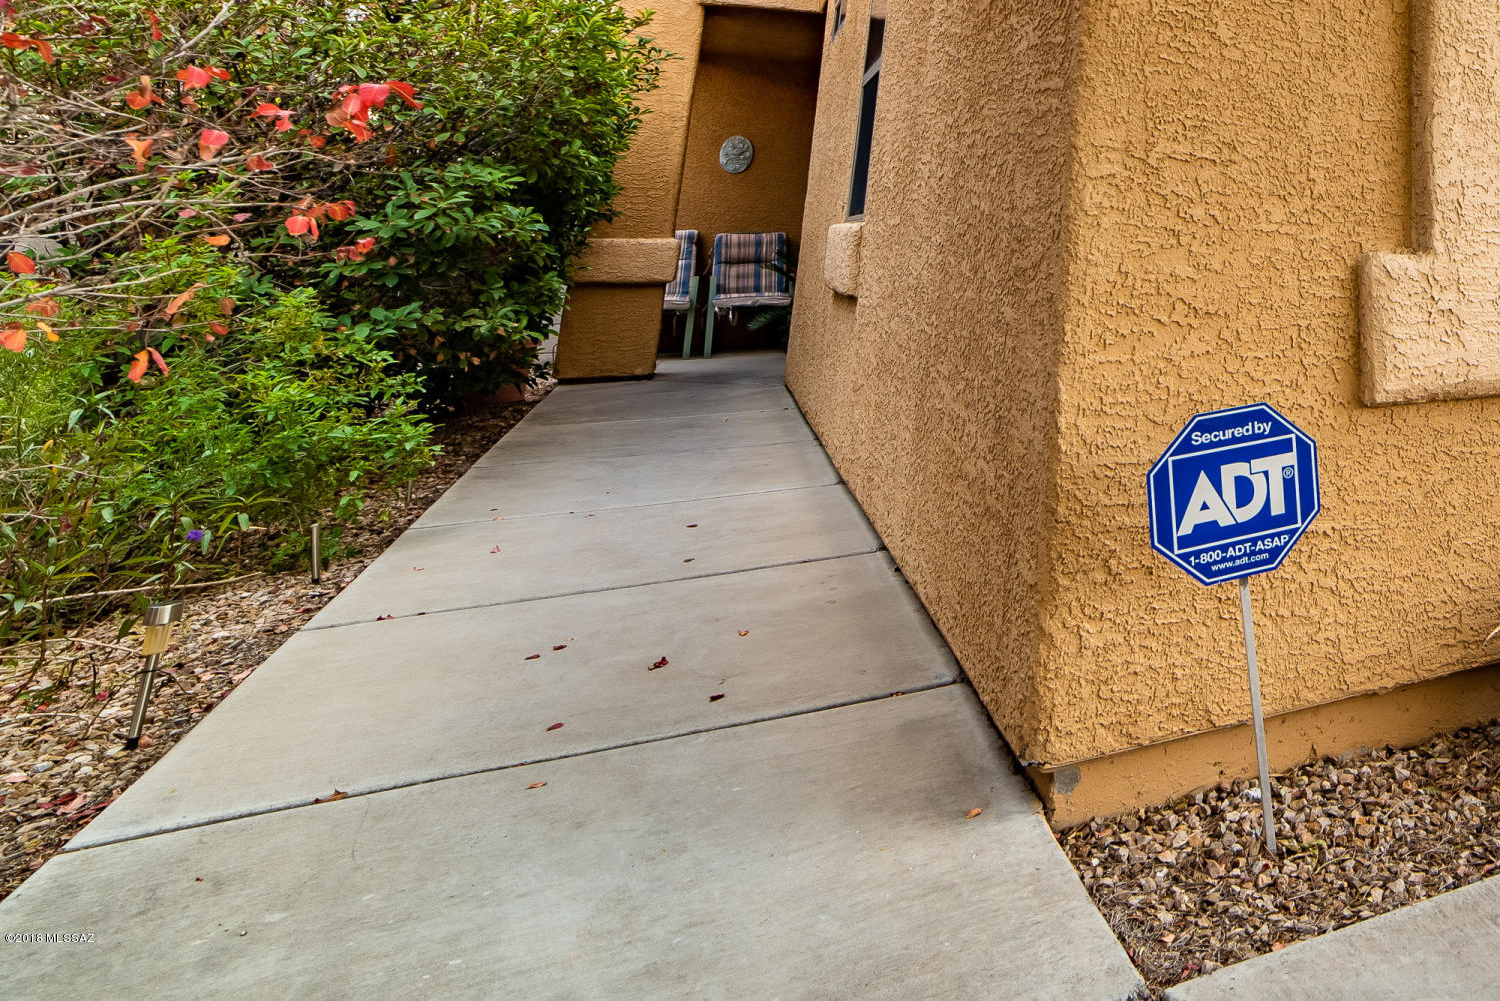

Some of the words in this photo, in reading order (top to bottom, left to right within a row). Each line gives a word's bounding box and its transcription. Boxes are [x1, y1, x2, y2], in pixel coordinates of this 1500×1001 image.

[1191, 422, 1253, 445] Secured
[1254, 421, 1272, 435] by
[1189, 535, 1289, 566] 1-800-ADT-ASAP
[1211, 552, 1269, 572] www.adt.com
